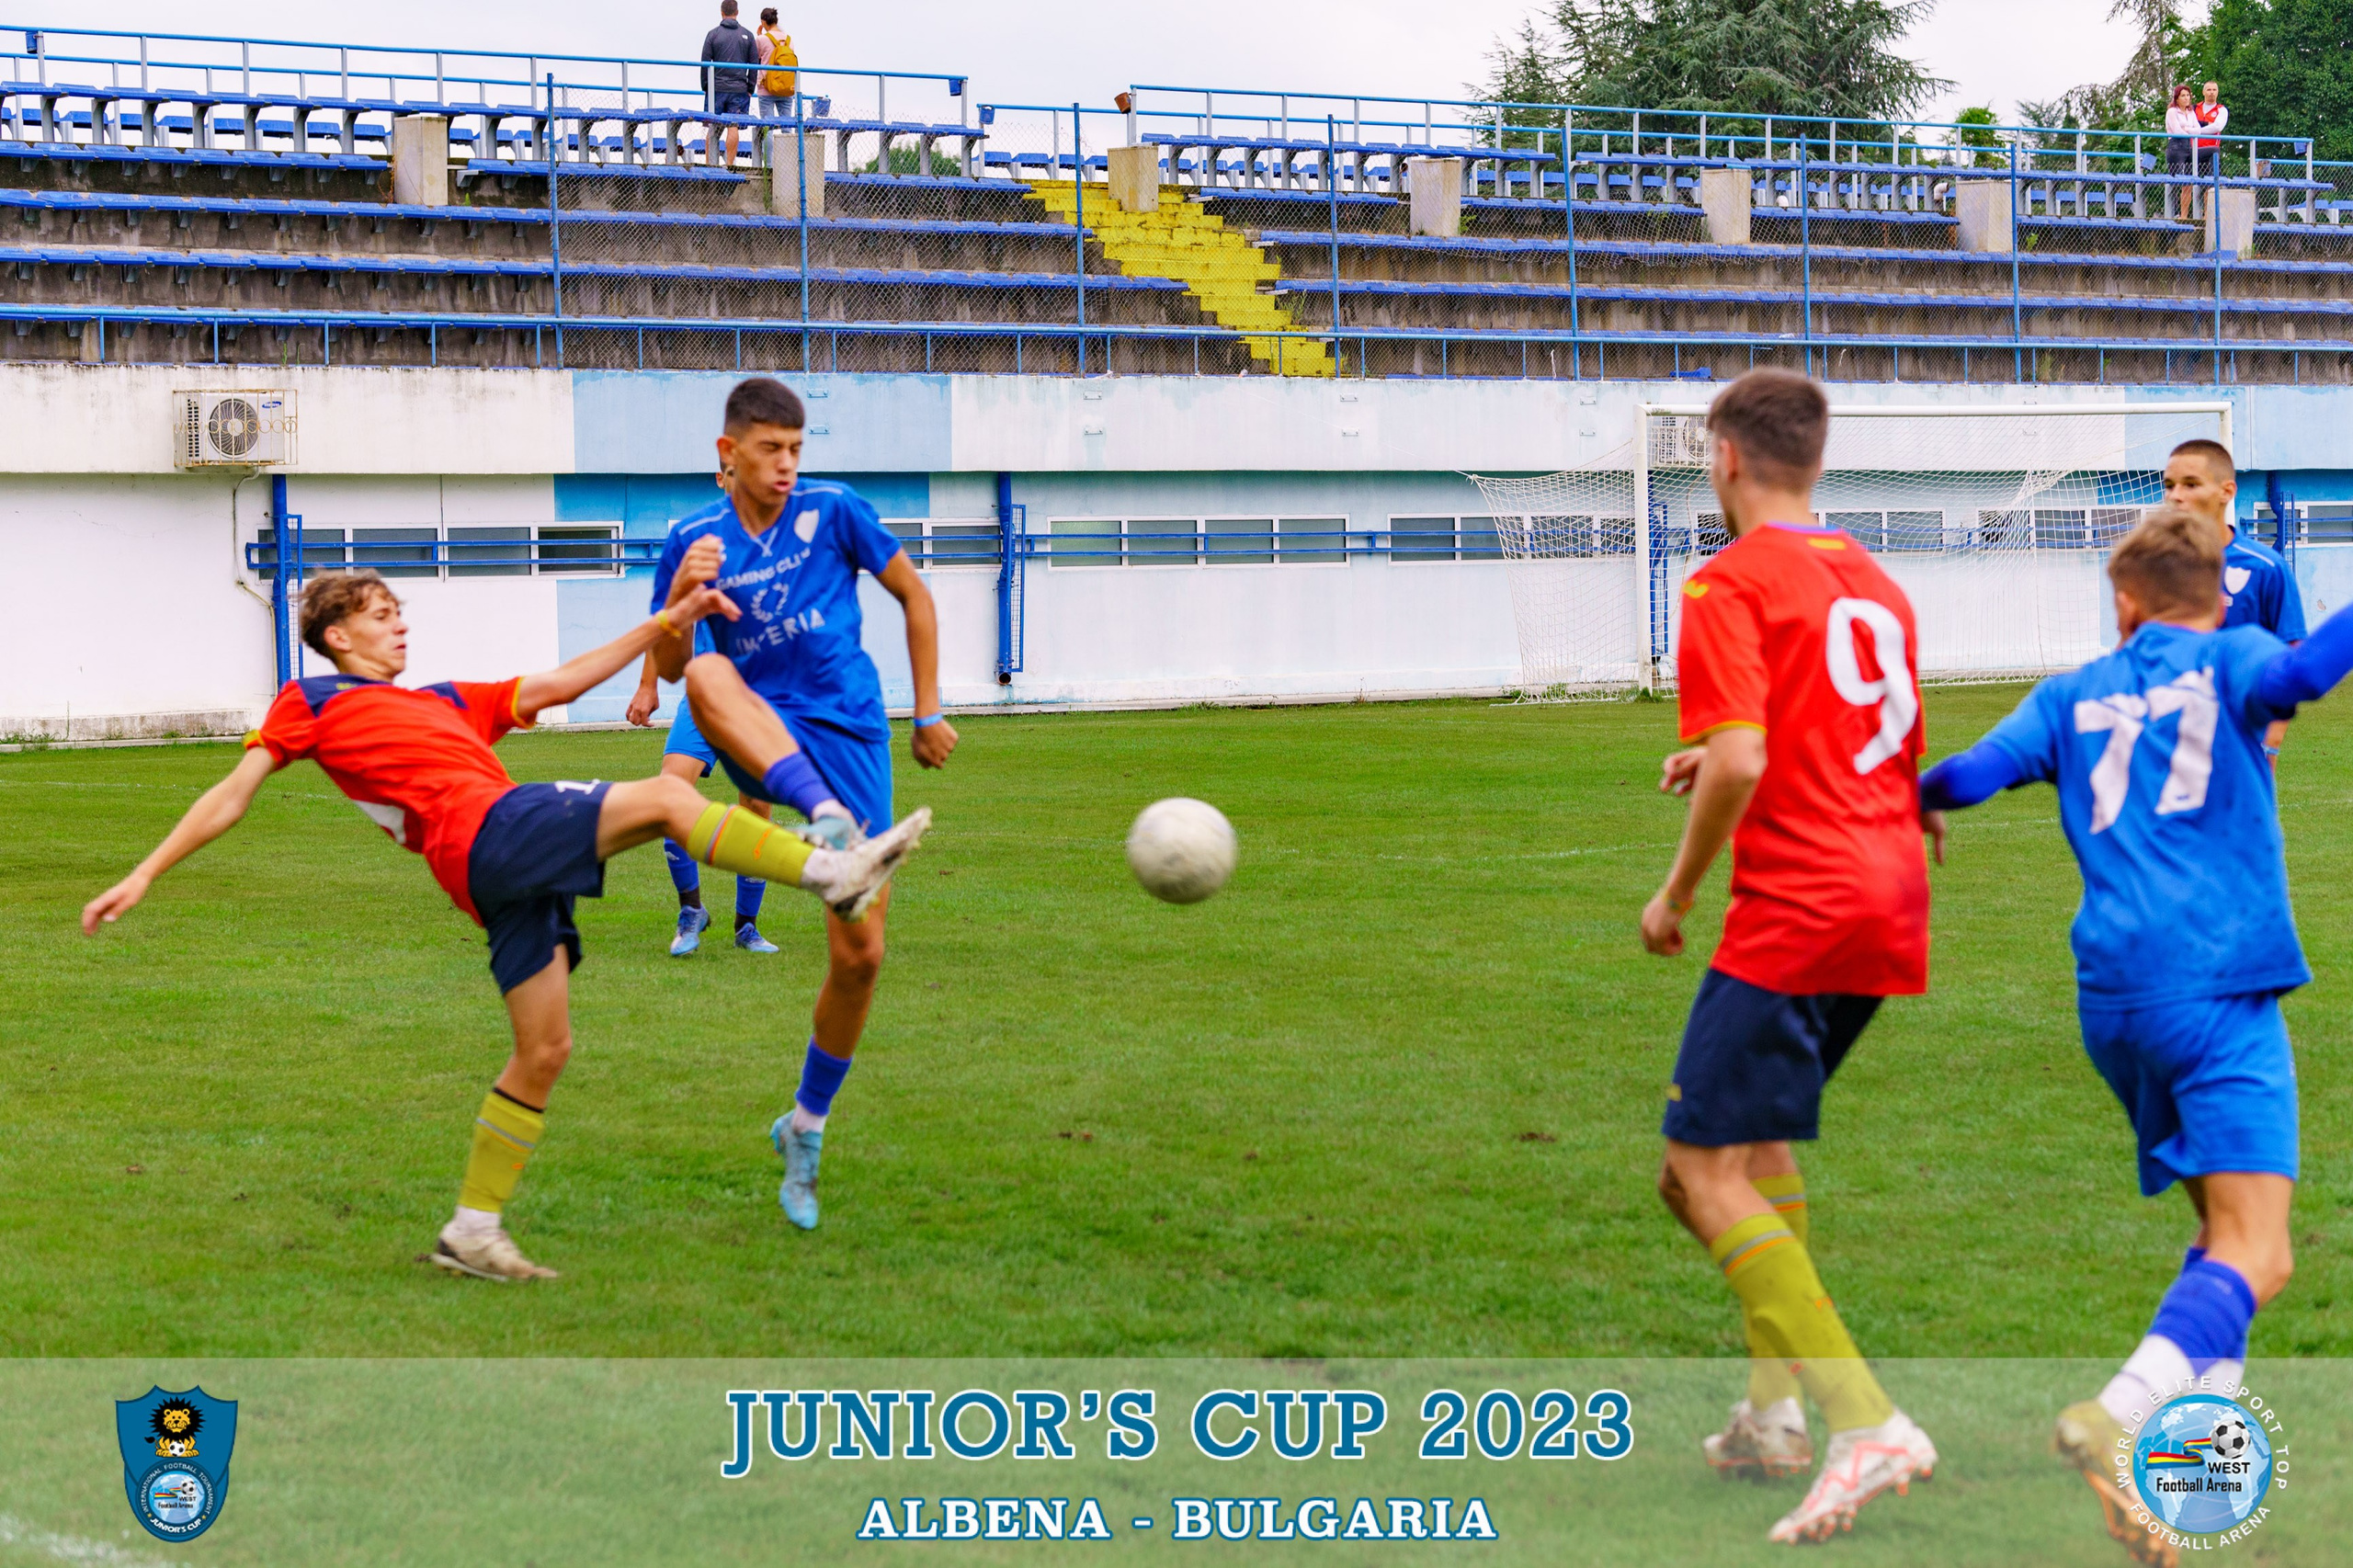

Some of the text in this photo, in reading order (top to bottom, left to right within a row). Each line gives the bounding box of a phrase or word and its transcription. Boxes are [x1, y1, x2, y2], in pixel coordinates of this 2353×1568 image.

[715, 547, 811, 591] GAMING CL
[735, 608, 825, 653] IMERIA
[1826, 597, 1918, 775] 9
[2074, 665, 2220, 835] 77
